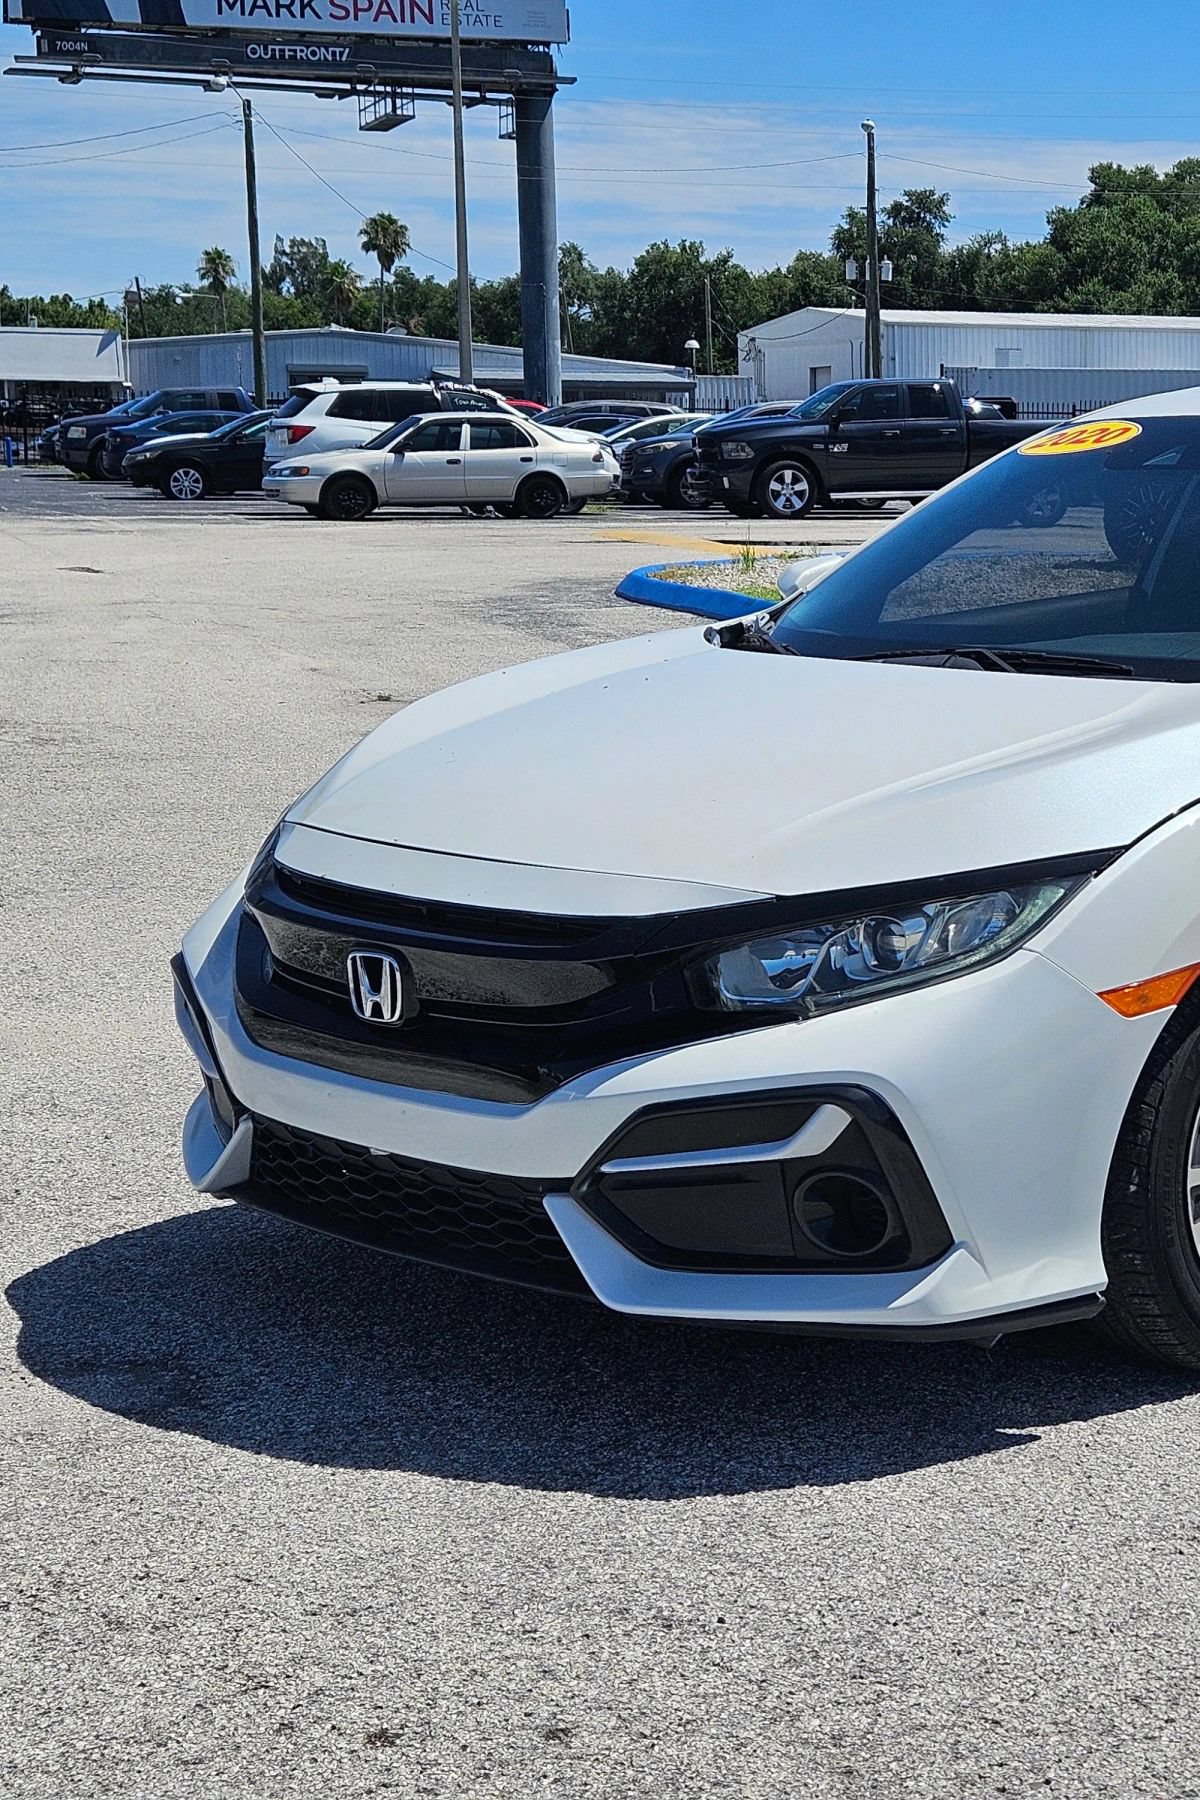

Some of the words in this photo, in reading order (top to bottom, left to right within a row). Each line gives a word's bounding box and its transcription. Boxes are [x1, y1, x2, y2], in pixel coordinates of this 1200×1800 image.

[217, 0, 323, 20] MARK
[328, 0, 434, 24] SPAIN
[55, 40, 88, 51] 7004N
[1028, 427, 1132, 448] 2020
